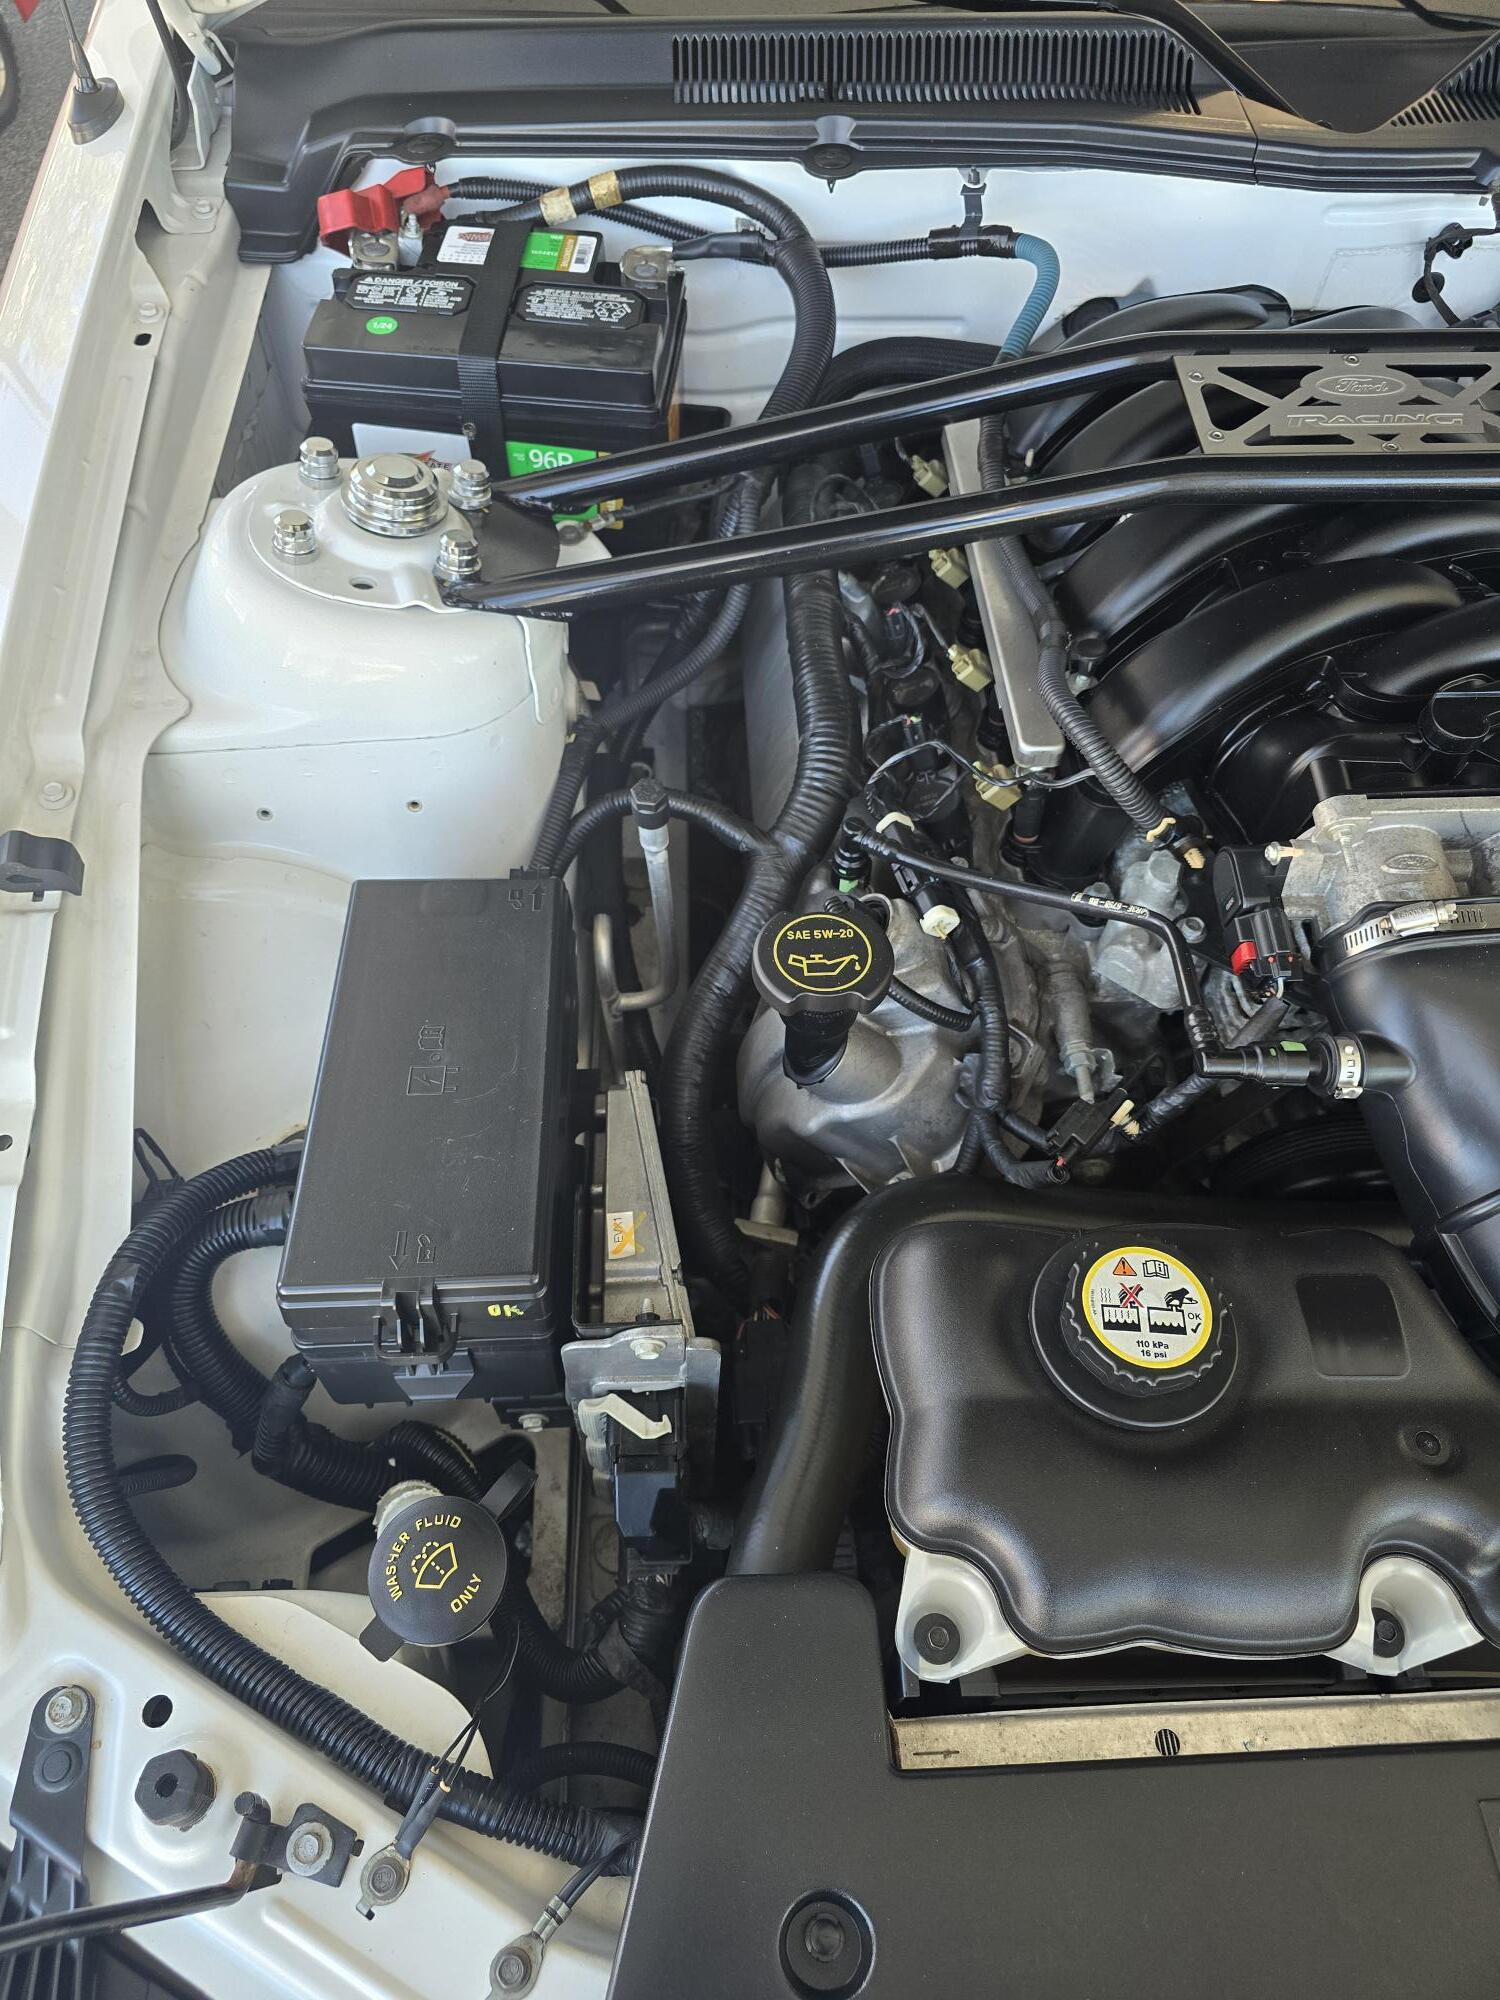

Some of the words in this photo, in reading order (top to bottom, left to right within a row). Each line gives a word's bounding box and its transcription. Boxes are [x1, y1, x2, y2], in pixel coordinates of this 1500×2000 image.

[374, 277, 413, 286] DANGER
[423, 280, 459, 288] POISON
[1335, 378, 1390, 393] Ford
[1286, 414, 1464, 427] RACING
[787, 931, 811, 940] SAE
[813, 929, 854, 939] 5W-20
[487, 1304, 524, 1318] OK
[1187, 1312, 1202, 1321] OK
[1136, 1340, 1150, 1348] 110
[1152, 1341, 1169, 1350] kPa
[1141, 1350, 1152, 1358] 16
[1154, 1351, 1167, 1359] psi
[385, 1531, 411, 1602] WASHER
[415, 1514, 462, 1532] FLUID
[450, 1573, 482, 1613] ONLY
